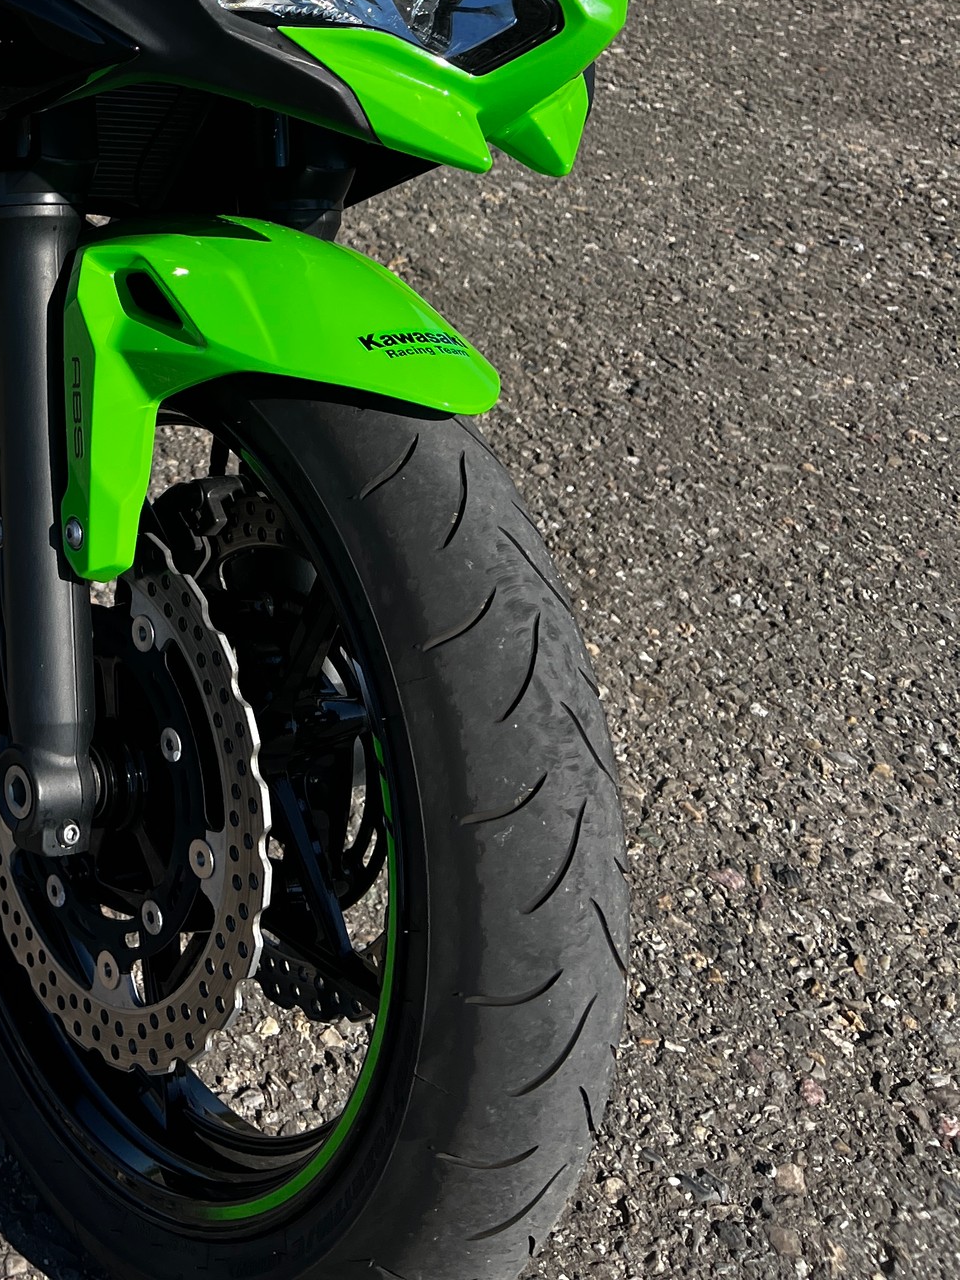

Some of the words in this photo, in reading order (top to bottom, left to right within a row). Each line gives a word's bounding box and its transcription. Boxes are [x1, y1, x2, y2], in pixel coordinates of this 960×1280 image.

[357, 331, 469, 351] Kawasaki
[385, 346, 436, 359] Racing
[436, 346, 470, 358] Team
[71, 356, 85, 460] ABS
